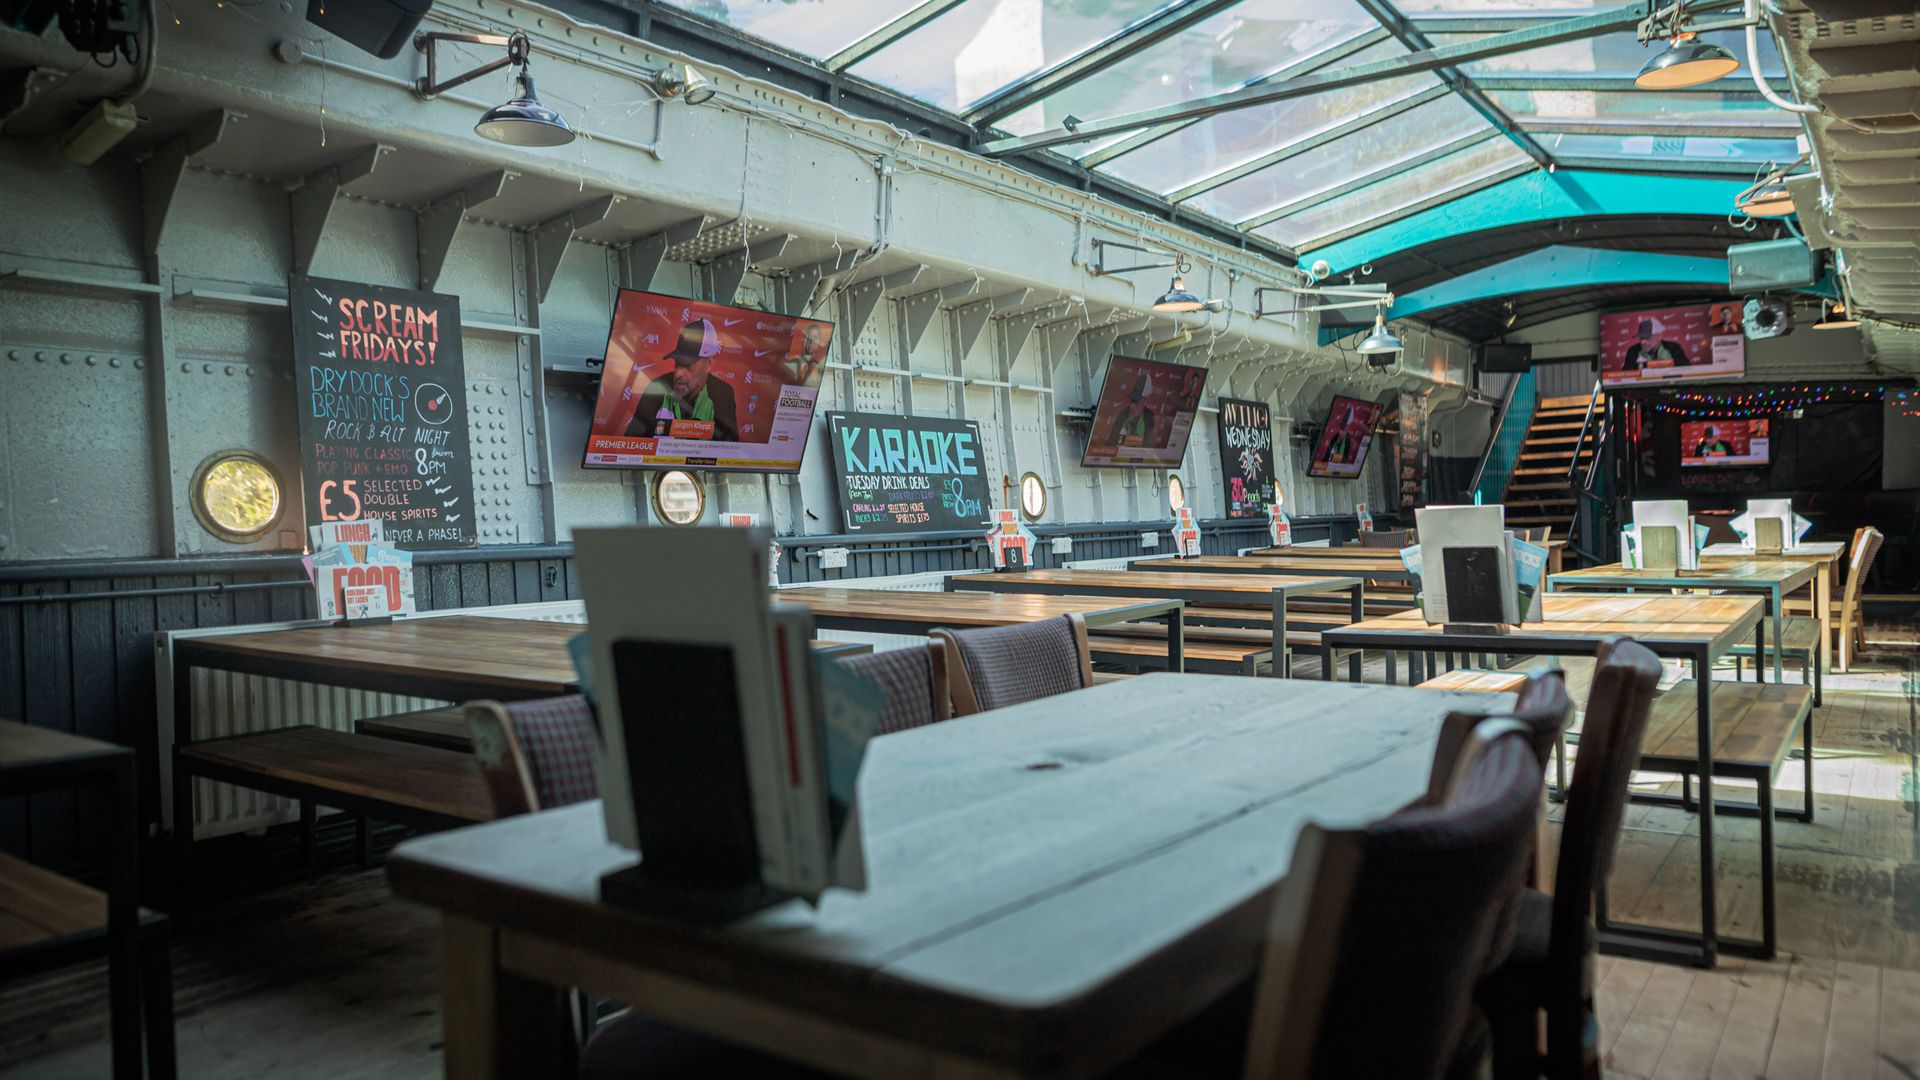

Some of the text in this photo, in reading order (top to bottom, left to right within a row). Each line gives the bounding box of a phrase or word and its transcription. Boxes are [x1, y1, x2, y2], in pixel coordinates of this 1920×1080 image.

[338, 297, 439, 343] SCREAM
[339, 329, 437, 367] FRIDAYS!
[310, 365, 411, 400] DRY DOCK'S
[784, 390, 801, 399] TOTAL
[311, 392, 405, 423] BRAND NEW
[781, 398, 810, 408] FOOTBALL
[324, 419, 362, 442] ROCK
[379, 424, 407, 443] ALT
[414, 426, 451, 446] NIGHT
[315, 443, 413, 461] PLAYING CLASSIC
[595, 439, 654, 450] PREMIER LEAGUE
[841, 426, 978, 475] KARAOKE
[317, 461, 337, 475] POP
[343, 461, 371, 476] PUNK
[385, 463, 409, 475] EMO
[363, 479, 423, 493] SELECTED
[846, 475, 930, 490] TUESDAY DRINK DEALS
[319, 479, 362, 521] £5
[364, 493, 410, 506] DOUBLE
[887, 502, 925, 513] SELECTED HOUSE
[363, 508, 438, 521] HOUSE SPIRITS
[895, 513, 916, 524] SPIRITS
[334, 523, 371, 543] LUNCH
[384, 527, 463, 543] NEVER A PHASE!
[1011, 548, 1017, 564] 8
